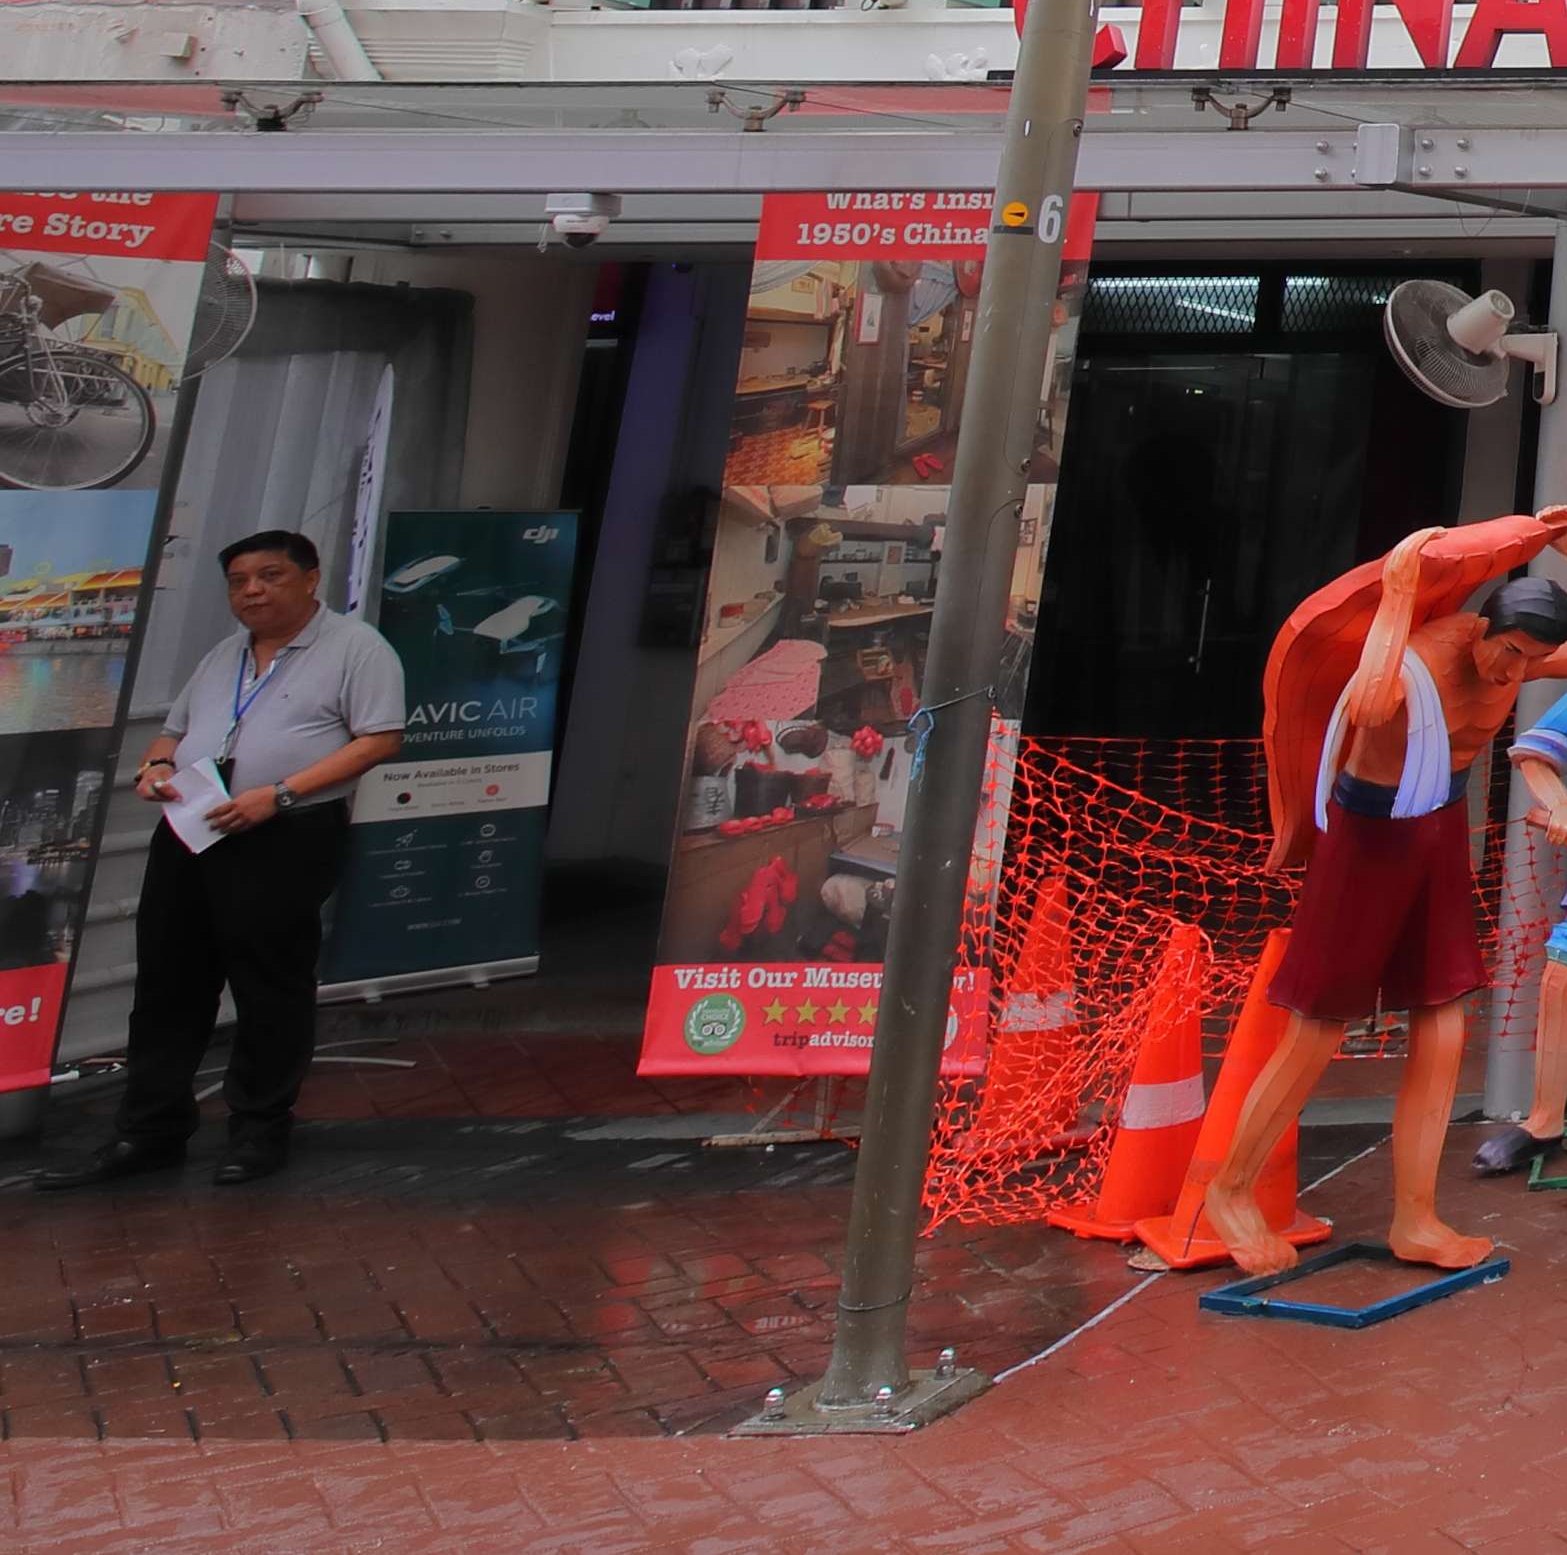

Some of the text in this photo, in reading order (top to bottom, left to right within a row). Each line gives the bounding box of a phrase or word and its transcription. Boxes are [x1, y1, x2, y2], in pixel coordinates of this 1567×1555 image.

[43, 212, 156, 249] Story
[1038, 194, 1063, 244] 6
[796, 222, 989, 246] 1950's China
[406, 697, 538, 726] AVIC AIR
[401, 725, 527, 745] DVENTURE UNFOLDS
[383, 761, 521, 782] Now Available in Stores
[673, 967, 741, 989] Visit
[747, 967, 799, 988] Our
[773, 1030, 875, 1051] tripadvisor
